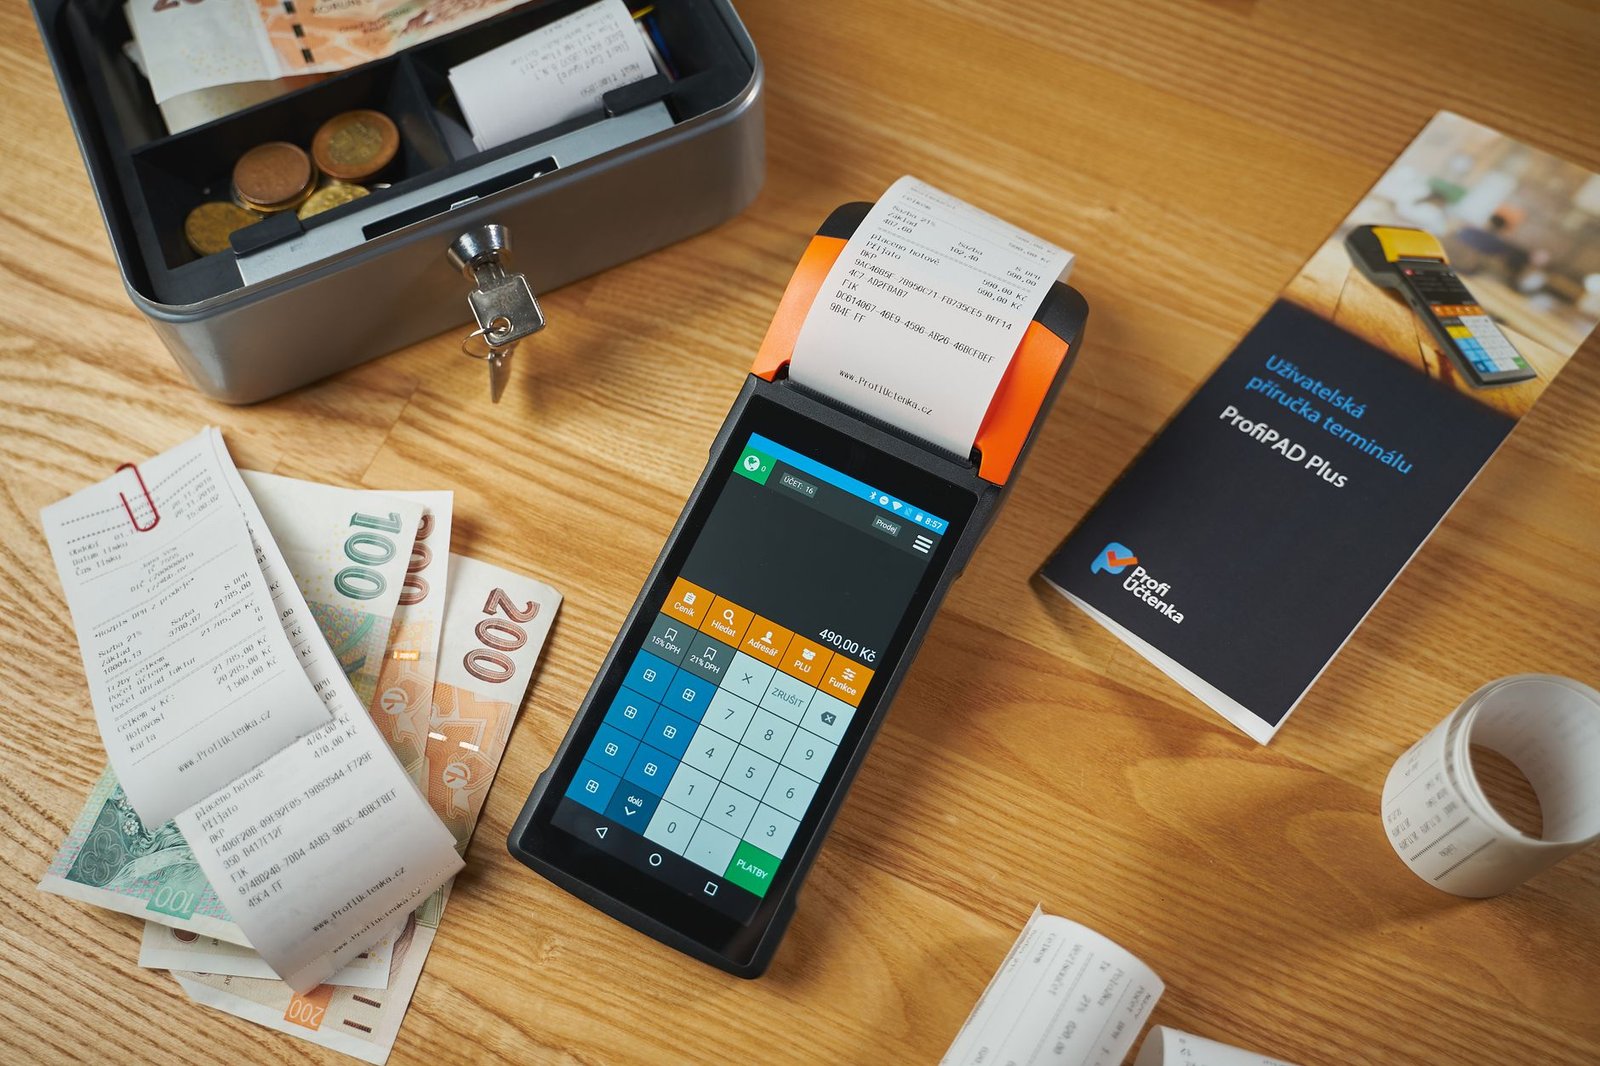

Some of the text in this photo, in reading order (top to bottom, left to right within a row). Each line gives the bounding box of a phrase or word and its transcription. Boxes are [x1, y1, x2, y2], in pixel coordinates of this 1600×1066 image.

[976, 286, 1008, 304] 590,00
[981, 279, 1013, 295] 590,00
[1265, 354, 1367, 419] Uživatelská
[1245, 376, 1413, 475] příručka terminálu
[1219, 405, 1348, 489] ProfiPAD Plus
[783, 475, 814, 495] ÚČET: 16
[875, 518, 897, 534] Prodej
[924, 517, 943, 530] 8:57
[334, 511, 403, 600] 100
[1130, 566, 1171, 597] Profi
[673, 601, 695, 617] Ceník
[1122, 576, 1185, 625] Účtenka
[462, 587, 541, 684] 200
[710, 619, 736, 637] Hledat
[651, 635, 681, 655] 15% DPH
[747, 637, 779, 657] Adresář
[819, 629, 877, 662] 490,00 Kč
[689, 654, 720, 674] 21% DPH
[793, 660, 811, 674] PLU
[829, 676, 858, 696] Funkce
[771, 686, 805, 709] ZRUŠIT
[723, 709, 735, 720] 7
[763, 729, 774, 741] 8
[704, 747, 715, 759] 4
[805, 749, 815, 761] 9
[745, 767, 756, 779] 5
[687, 784, 695, 796] 1
[786, 787, 795, 799] 6
[627, 794, 643, 807] dolů
[725, 805, 737, 817] 2
[667, 821, 677, 834] 0
[766, 825, 776, 837] 3
[736, 858, 768, 880] PLATBY
[153, 886, 194, 914] 100
[289, 999, 325, 1027] 200
